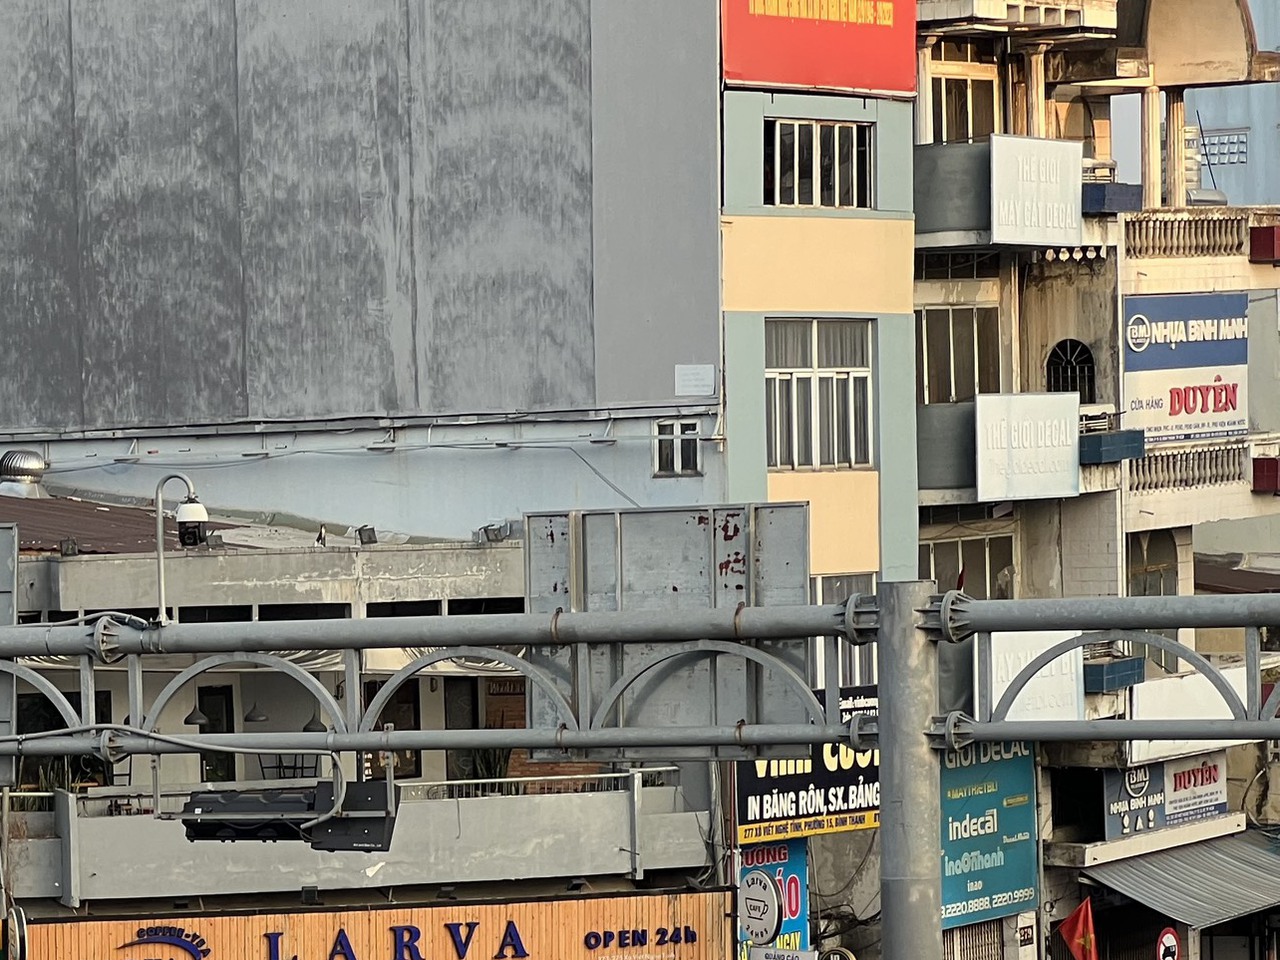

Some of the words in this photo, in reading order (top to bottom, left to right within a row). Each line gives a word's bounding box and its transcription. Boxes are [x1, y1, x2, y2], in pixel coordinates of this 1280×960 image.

[1151, 321, 1187, 350] NHỰA
[1169, 375, 1239, 416] DUYÊN
[1173, 761, 1219, 792] DUYÊN
[748, 795, 760, 820] IN
[763, 788, 796, 820] BĂNG
[848, 775, 880, 809] BẢNG
[948, 808, 998, 841] indecal
[745, 876, 768, 892] Larva
[992, 887, 1035, 908] 2220.9999
[749, 904, 761, 914] CAFE
[584, 929, 648, 950] OPEN
[655, 925, 697, 946] 24h
